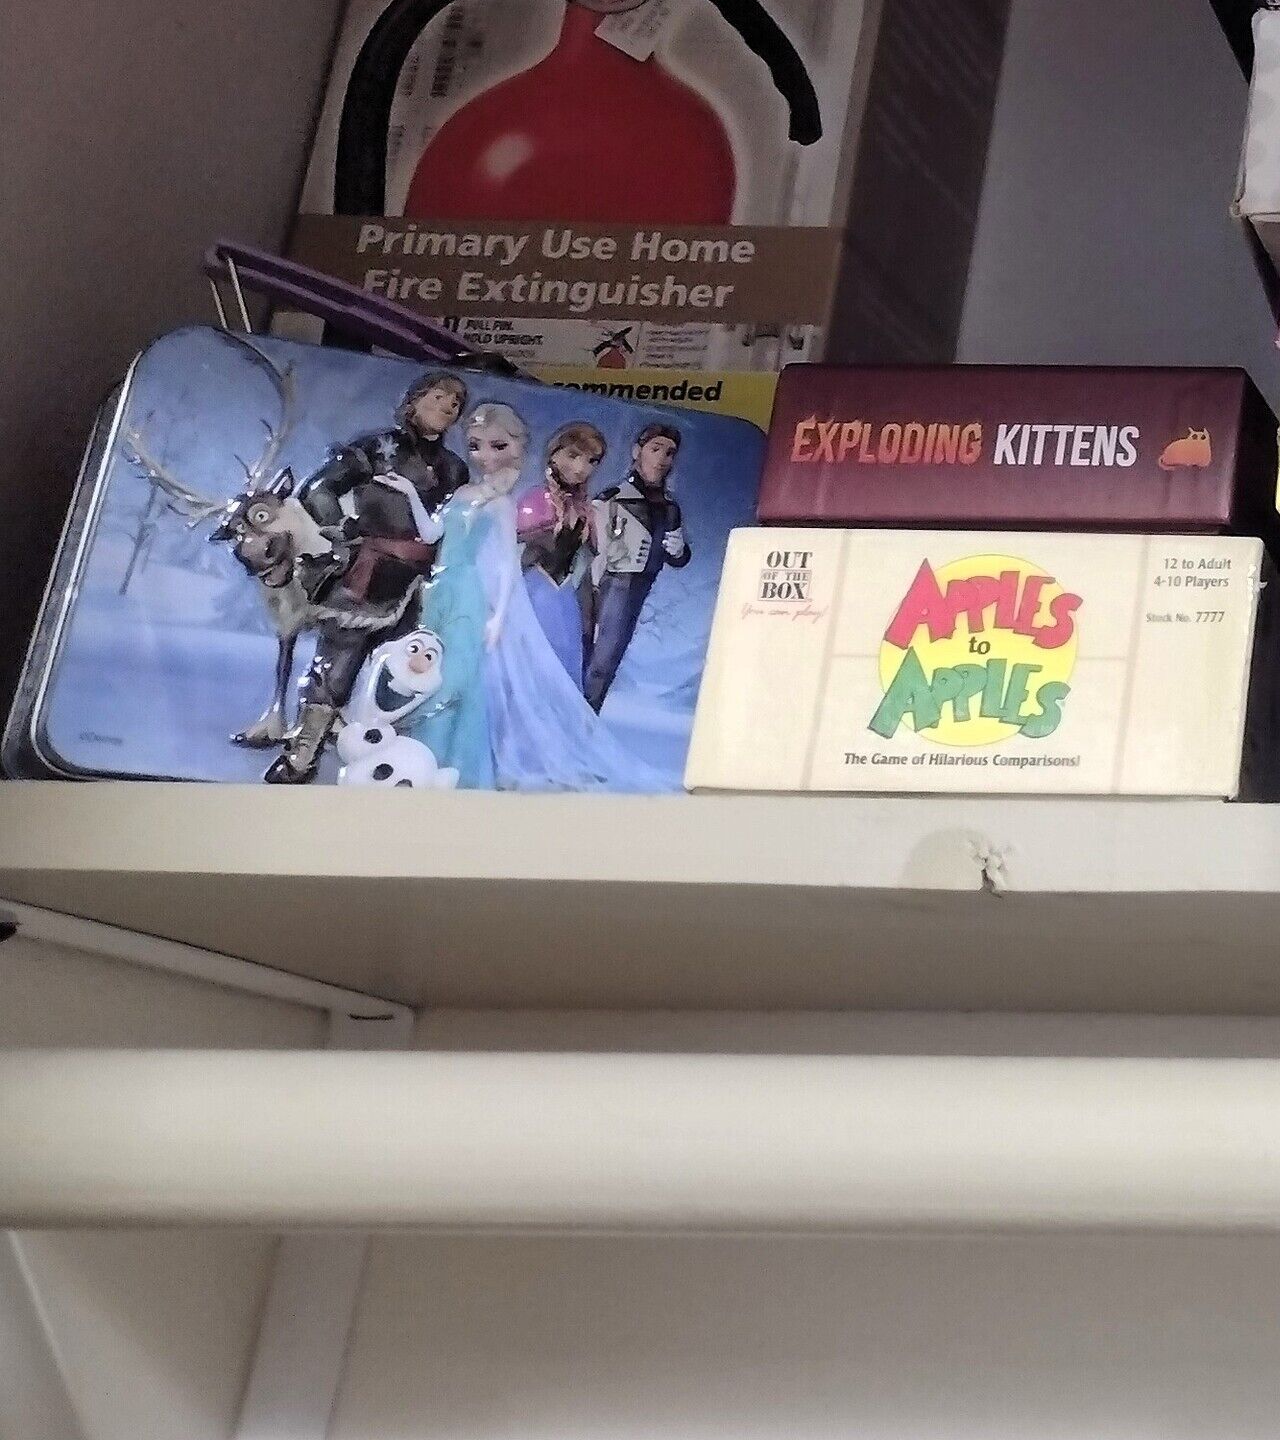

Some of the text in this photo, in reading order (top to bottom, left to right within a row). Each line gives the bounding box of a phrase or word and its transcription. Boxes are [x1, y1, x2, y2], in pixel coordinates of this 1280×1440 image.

[357, 224, 757, 266] Primary Use Home
[362, 268, 734, 312] Fire Extinguisher
[791, 416, 1140, 467] EXPLODING KITTENS
[767, 550, 813, 569] OUT
[1164, 558, 1232, 570] 12 to Adult
[762, 571, 811, 582] OF THE
[1153, 576, 1229, 590] 4-10 Players
[760, 582, 808, 600] BOX
[885, 558, 1083, 649] APPLES
[1195, 611, 1225, 623] 7777
[968, 634, 991, 657] to
[867, 646, 1072, 740] APPLES
[844, 752, 1081, 769] The Game of Hilarious Comparisons!
